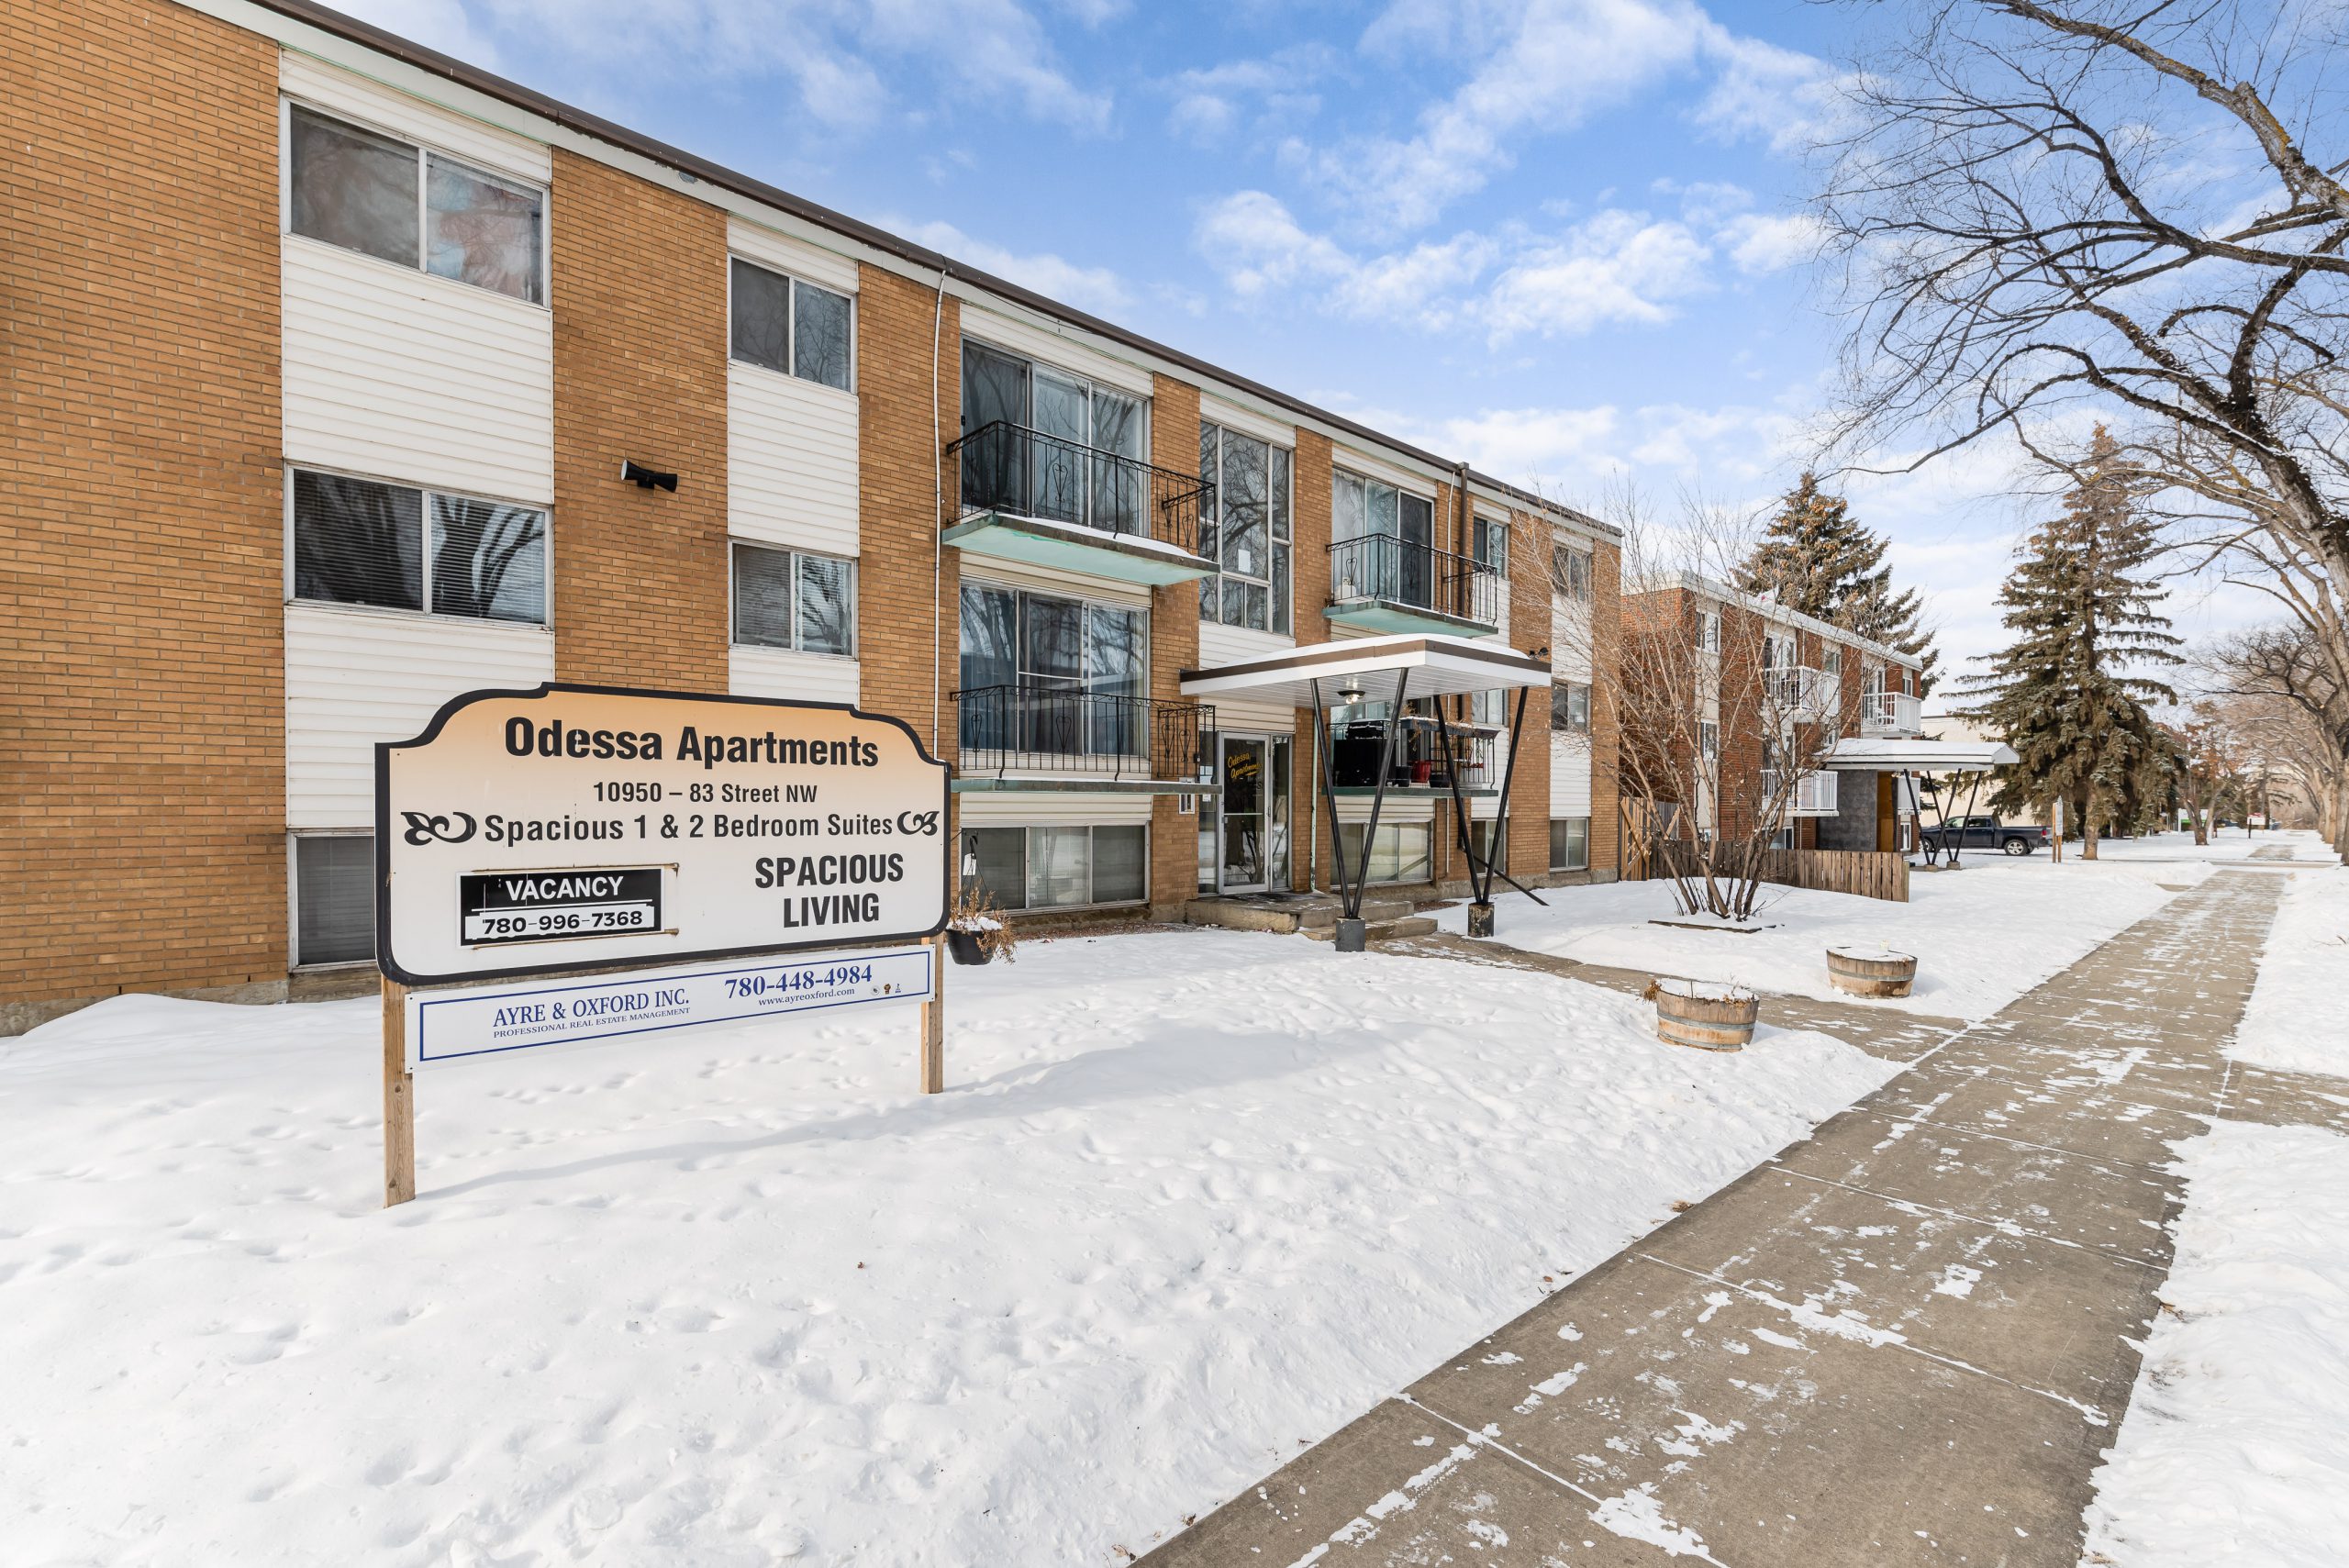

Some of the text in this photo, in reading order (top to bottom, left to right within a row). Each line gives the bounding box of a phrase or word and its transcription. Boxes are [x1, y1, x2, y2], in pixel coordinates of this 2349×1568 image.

[506, 717, 879, 770] Odessa Apartments
[1227, 752, 1251, 768] Odessa
[593, 782, 662, 802] 10950
[689, 783, 714, 803] 83
[721, 783, 780, 803] Street
[785, 784, 818, 803] NW
[484, 813, 893, 848] Spacious 1 & 2 Bedroom Suites
[755, 853, 904, 888] SPACIOUS
[506, 876, 624, 901] VACANCY
[484, 911, 643, 935] 780-996-7368
[784, 893, 879, 928] LIVING
[724, 964, 873, 999] 780-448-4984
[758, 987, 855, 1006] www.ayreoxford.com
[493, 988, 690, 1028] AYRE & OXFORD INC.
[494, 1007, 691, 1039] PROFESSIONAL REAL ESTATE MANAGEMENT
